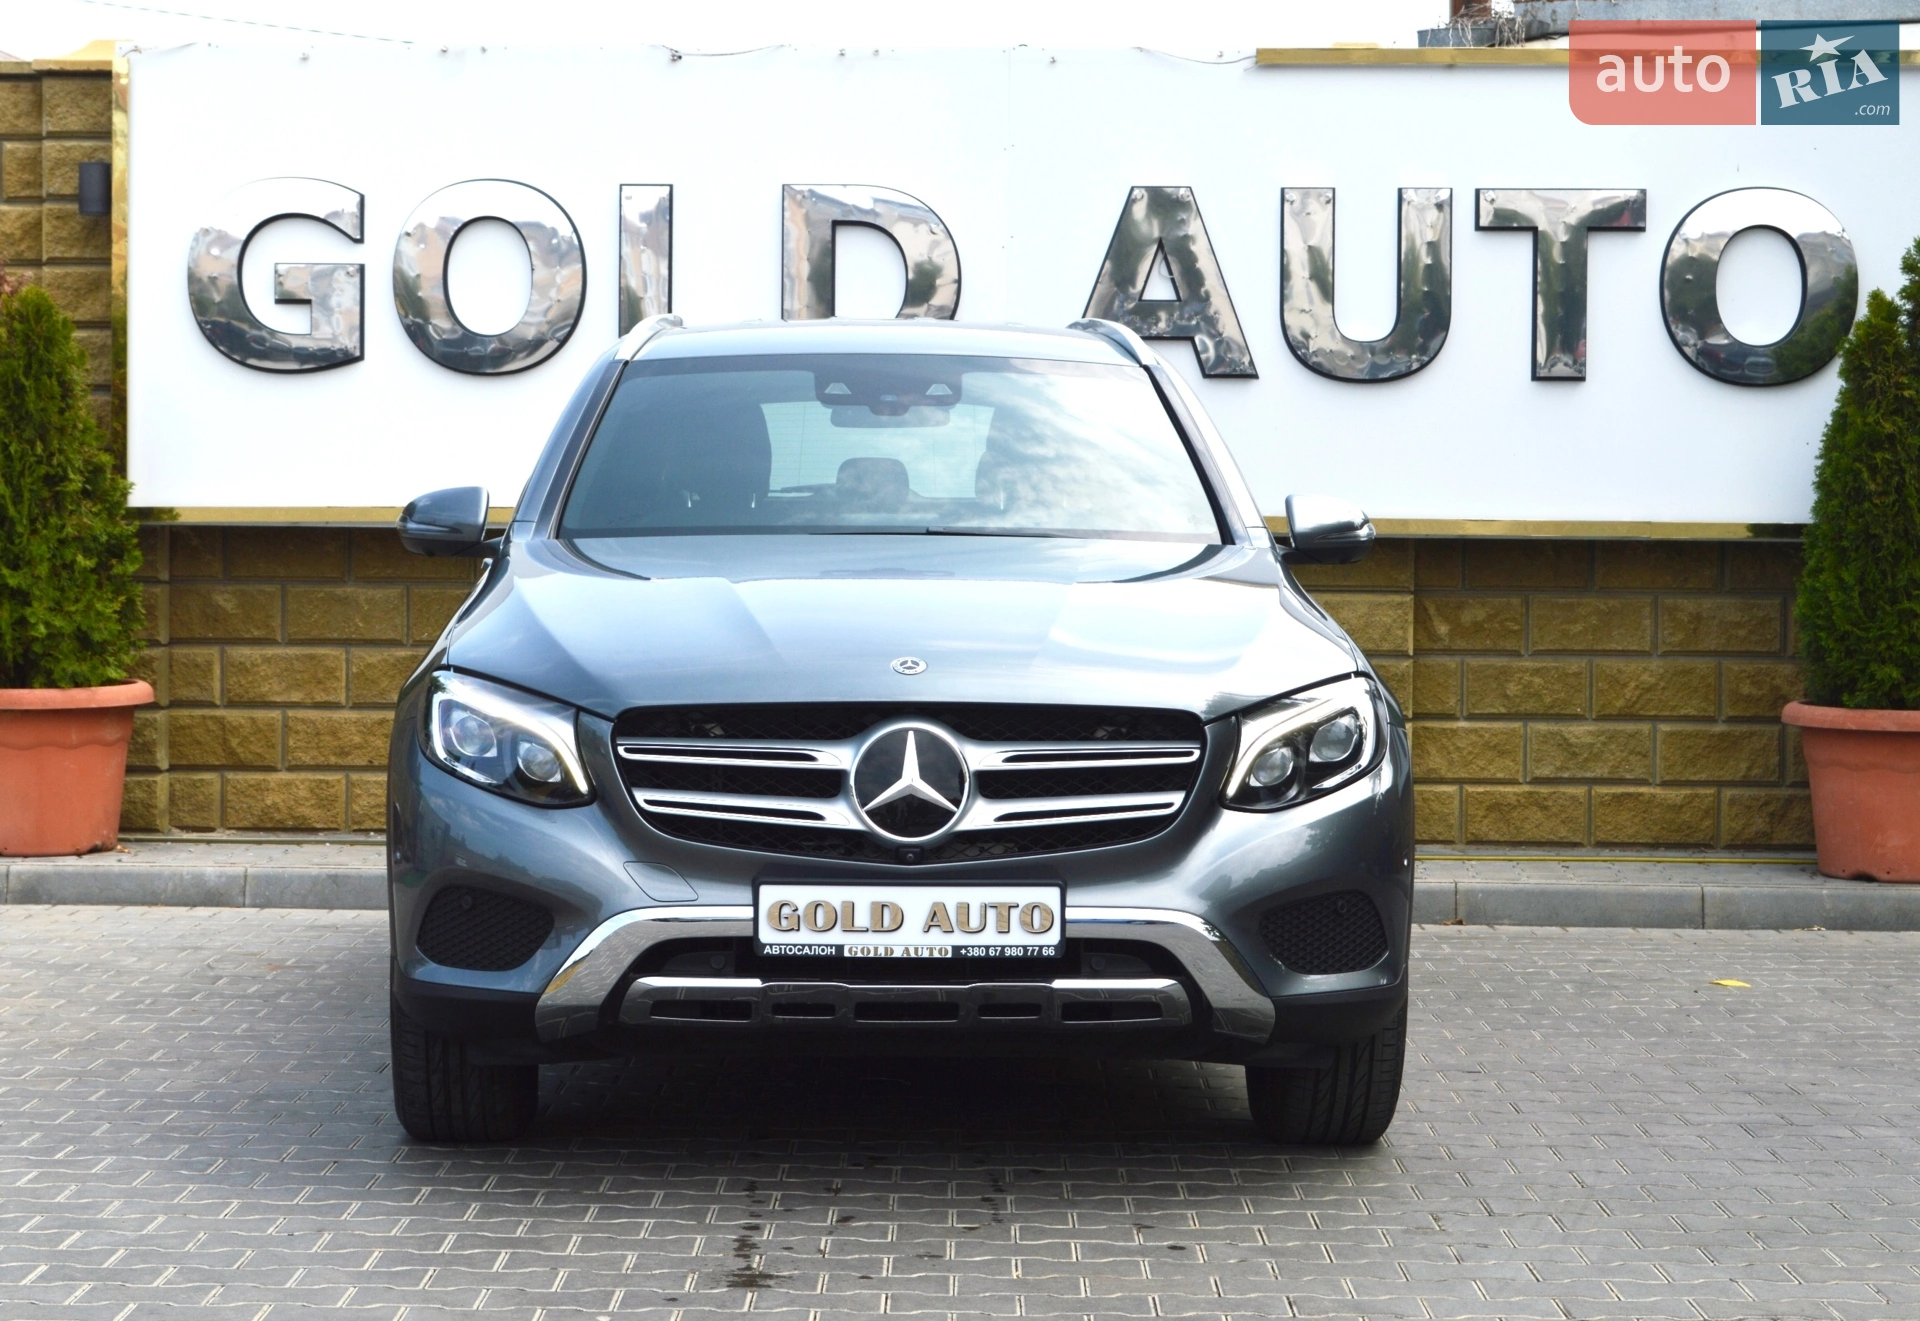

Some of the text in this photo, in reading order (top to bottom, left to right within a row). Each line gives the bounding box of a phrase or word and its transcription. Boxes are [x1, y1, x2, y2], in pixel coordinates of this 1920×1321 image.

[1083, 186, 1859, 387] AUTO
[767, 900, 1055, 934] GOLD AUTO
[763, 945, 1056, 957] АВТОСАЛОН GOLD AUTO +380 67 980 77 66
